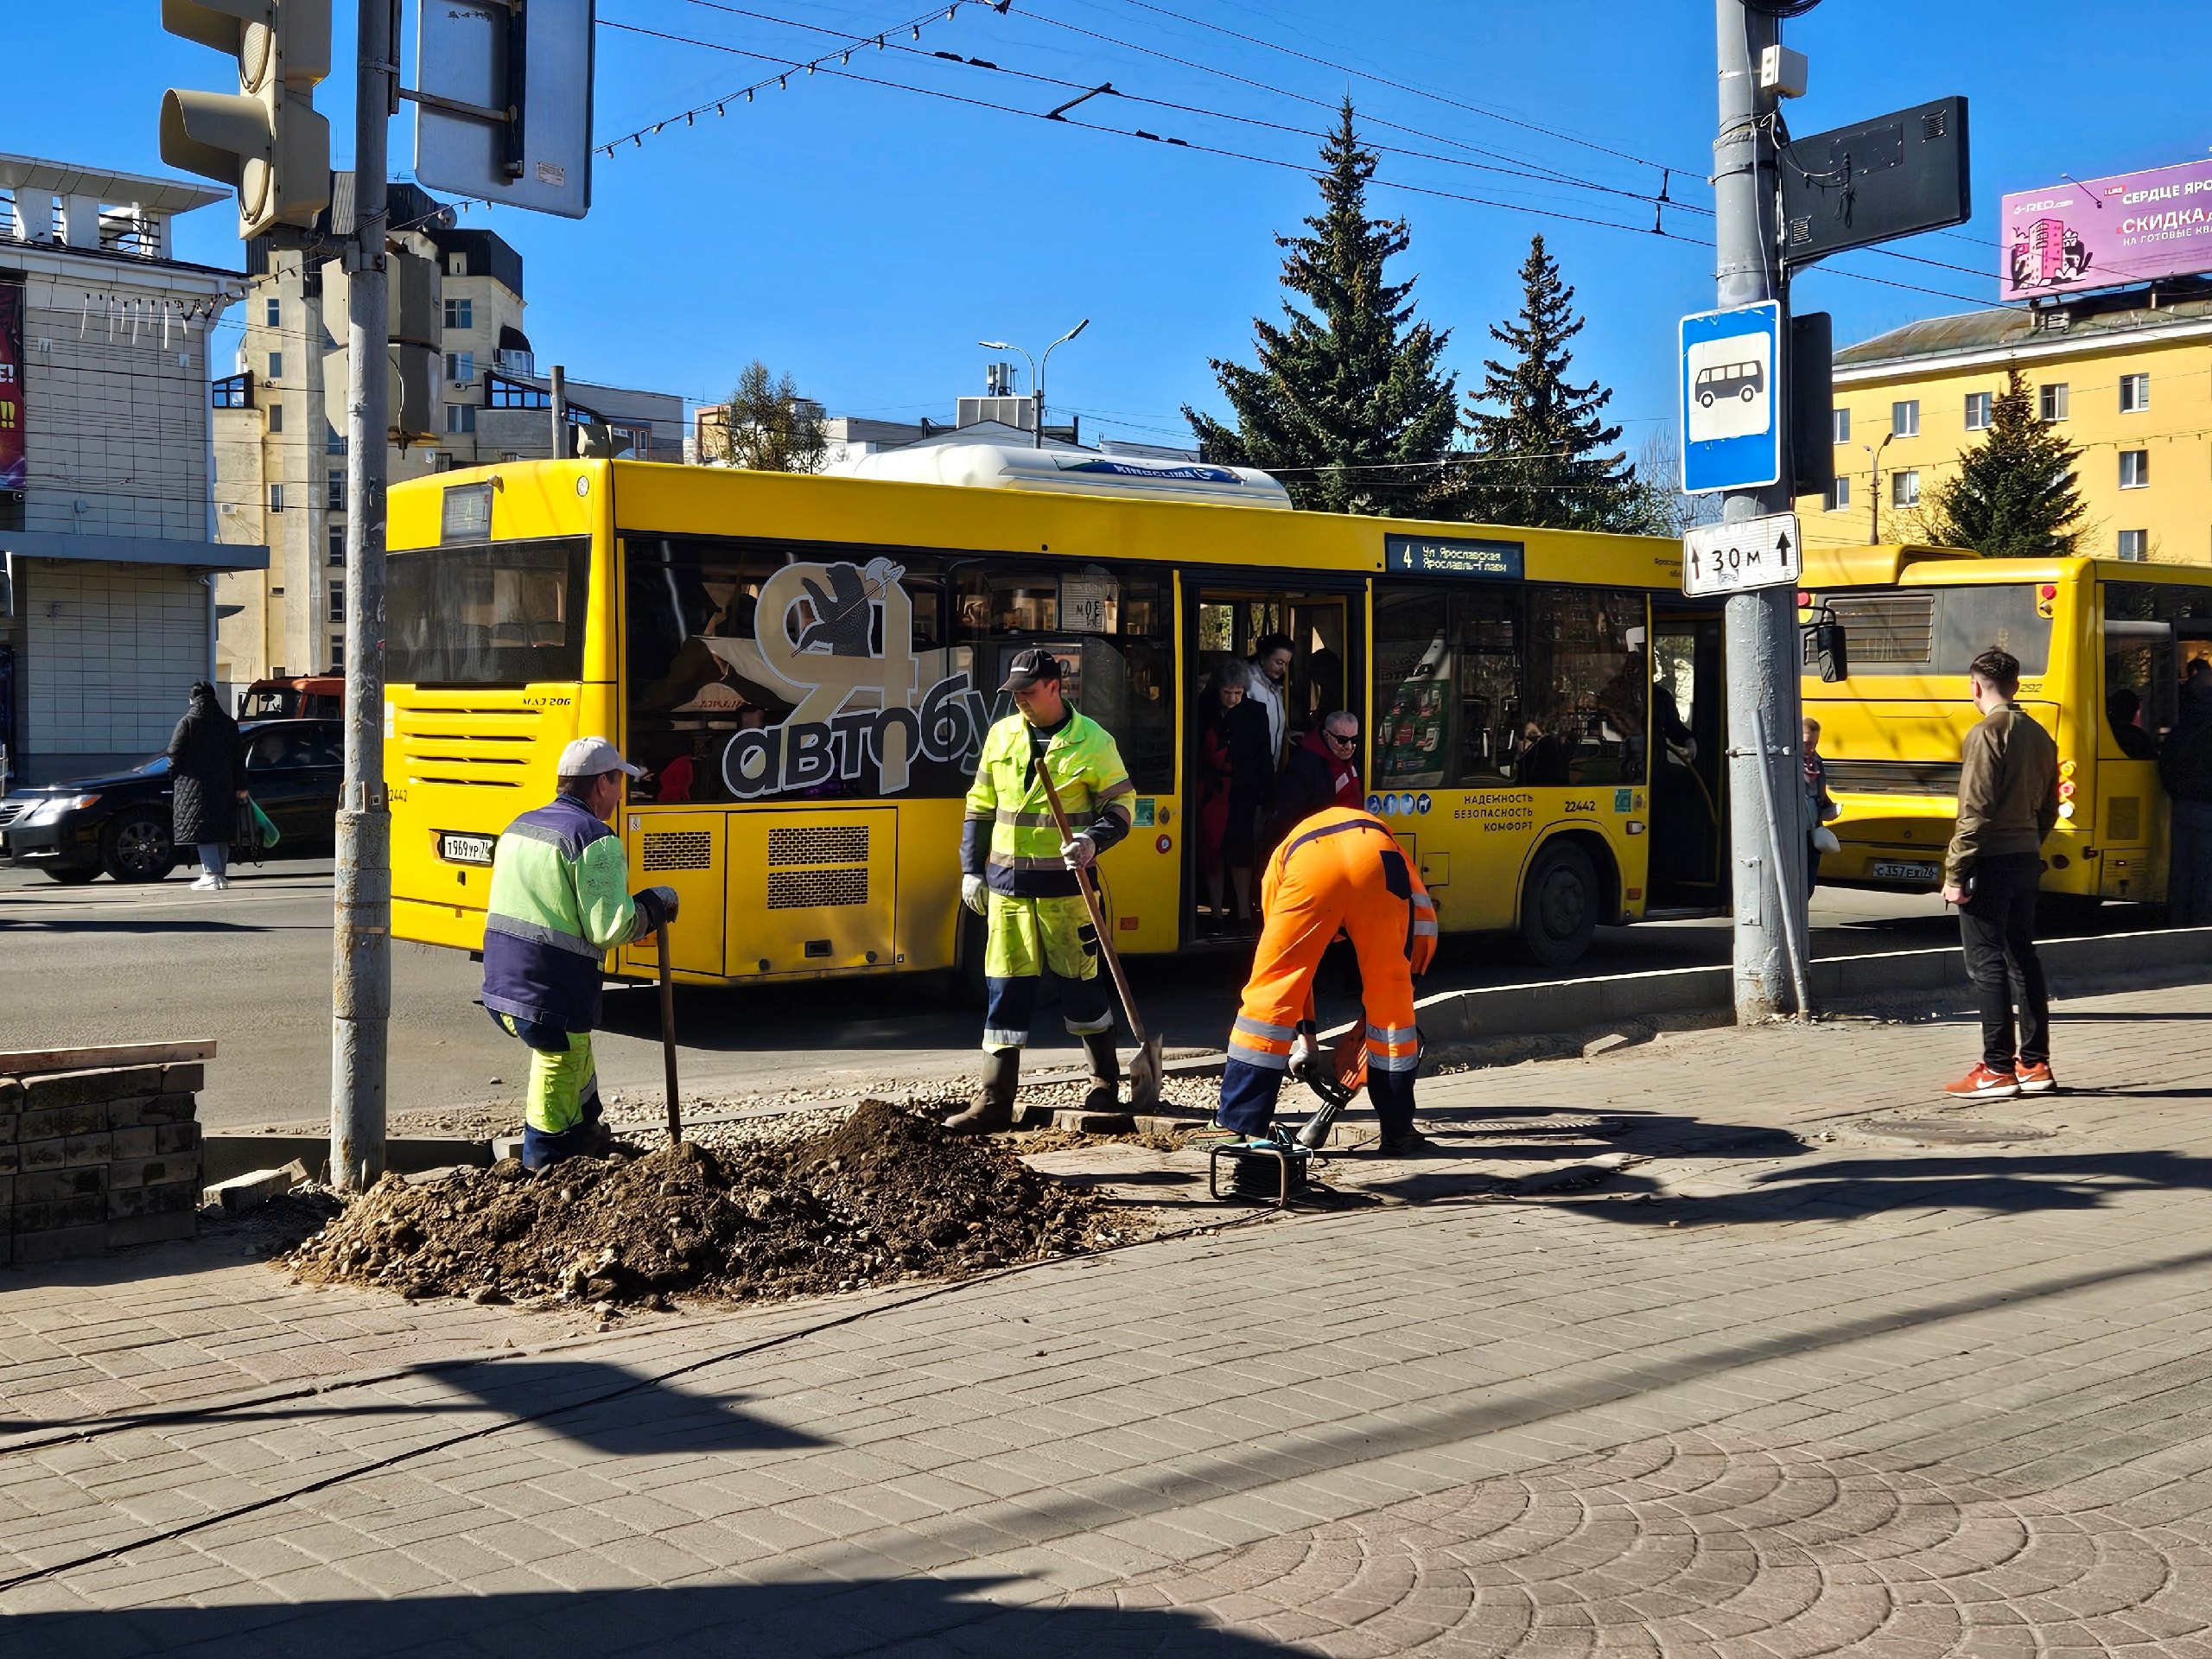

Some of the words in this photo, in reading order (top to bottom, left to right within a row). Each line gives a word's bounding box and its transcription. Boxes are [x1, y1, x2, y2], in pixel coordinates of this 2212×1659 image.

[2122, 184, 2180, 205] СЕРДЦЕ
[2122, 207, 2204, 233] СКИДКА
[2123, 237, 2137, 246] НА
[2140, 227, 2192, 244] ГОТОВЫЕ
[1113, 464, 1195, 478] KINGCLIMA
[1403, 545, 1413, 569] 4
[1440, 547, 1501, 562] Ярославская
[1712, 548, 1740, 572] 30
[1464, 793, 1534, 804] НАДЕЖНОСТЬ
[1565, 800, 1596, 812] 22442
[1453, 808, 1533, 819] БЕЗОПАСНОСТЬ
[1484, 821, 1533, 832] КОМФОРТ
